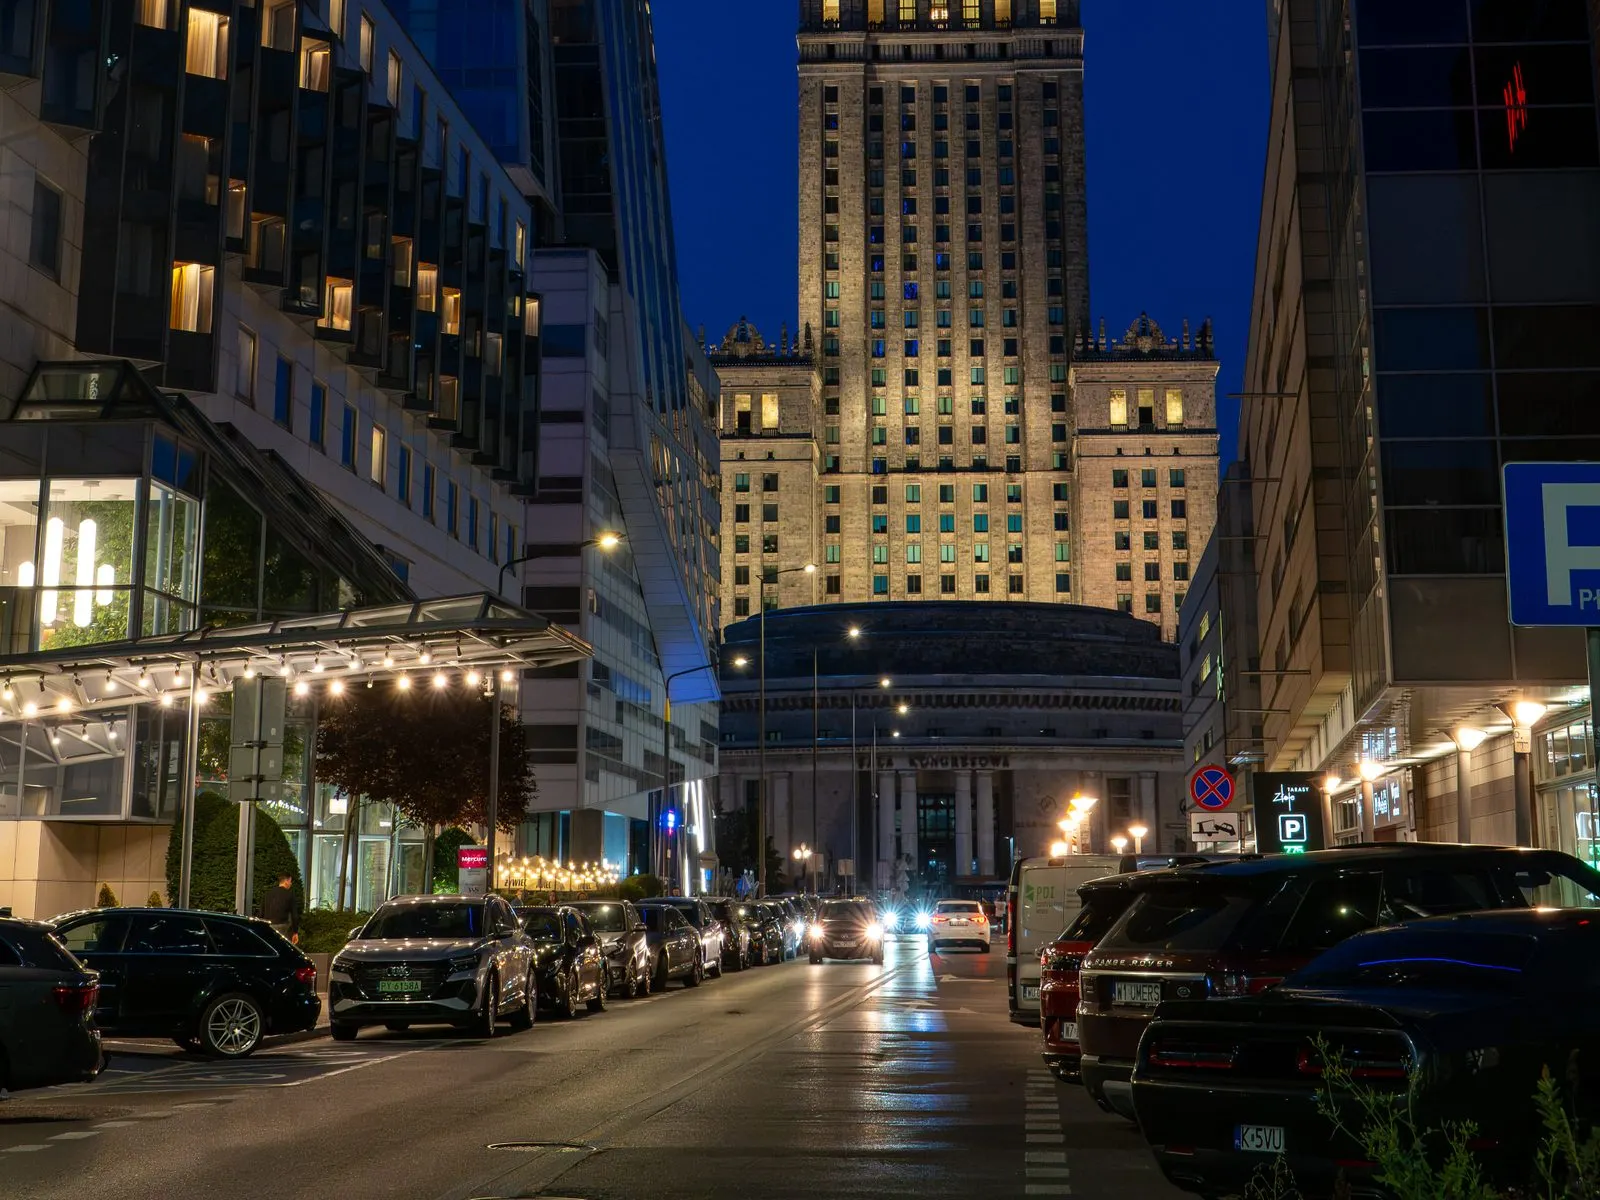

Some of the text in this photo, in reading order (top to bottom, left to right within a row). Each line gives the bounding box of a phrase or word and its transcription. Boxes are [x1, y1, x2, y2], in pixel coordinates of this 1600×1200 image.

[1285, 819, 1301, 839] P
[1093, 958, 1174, 968] RANGE ROVER
